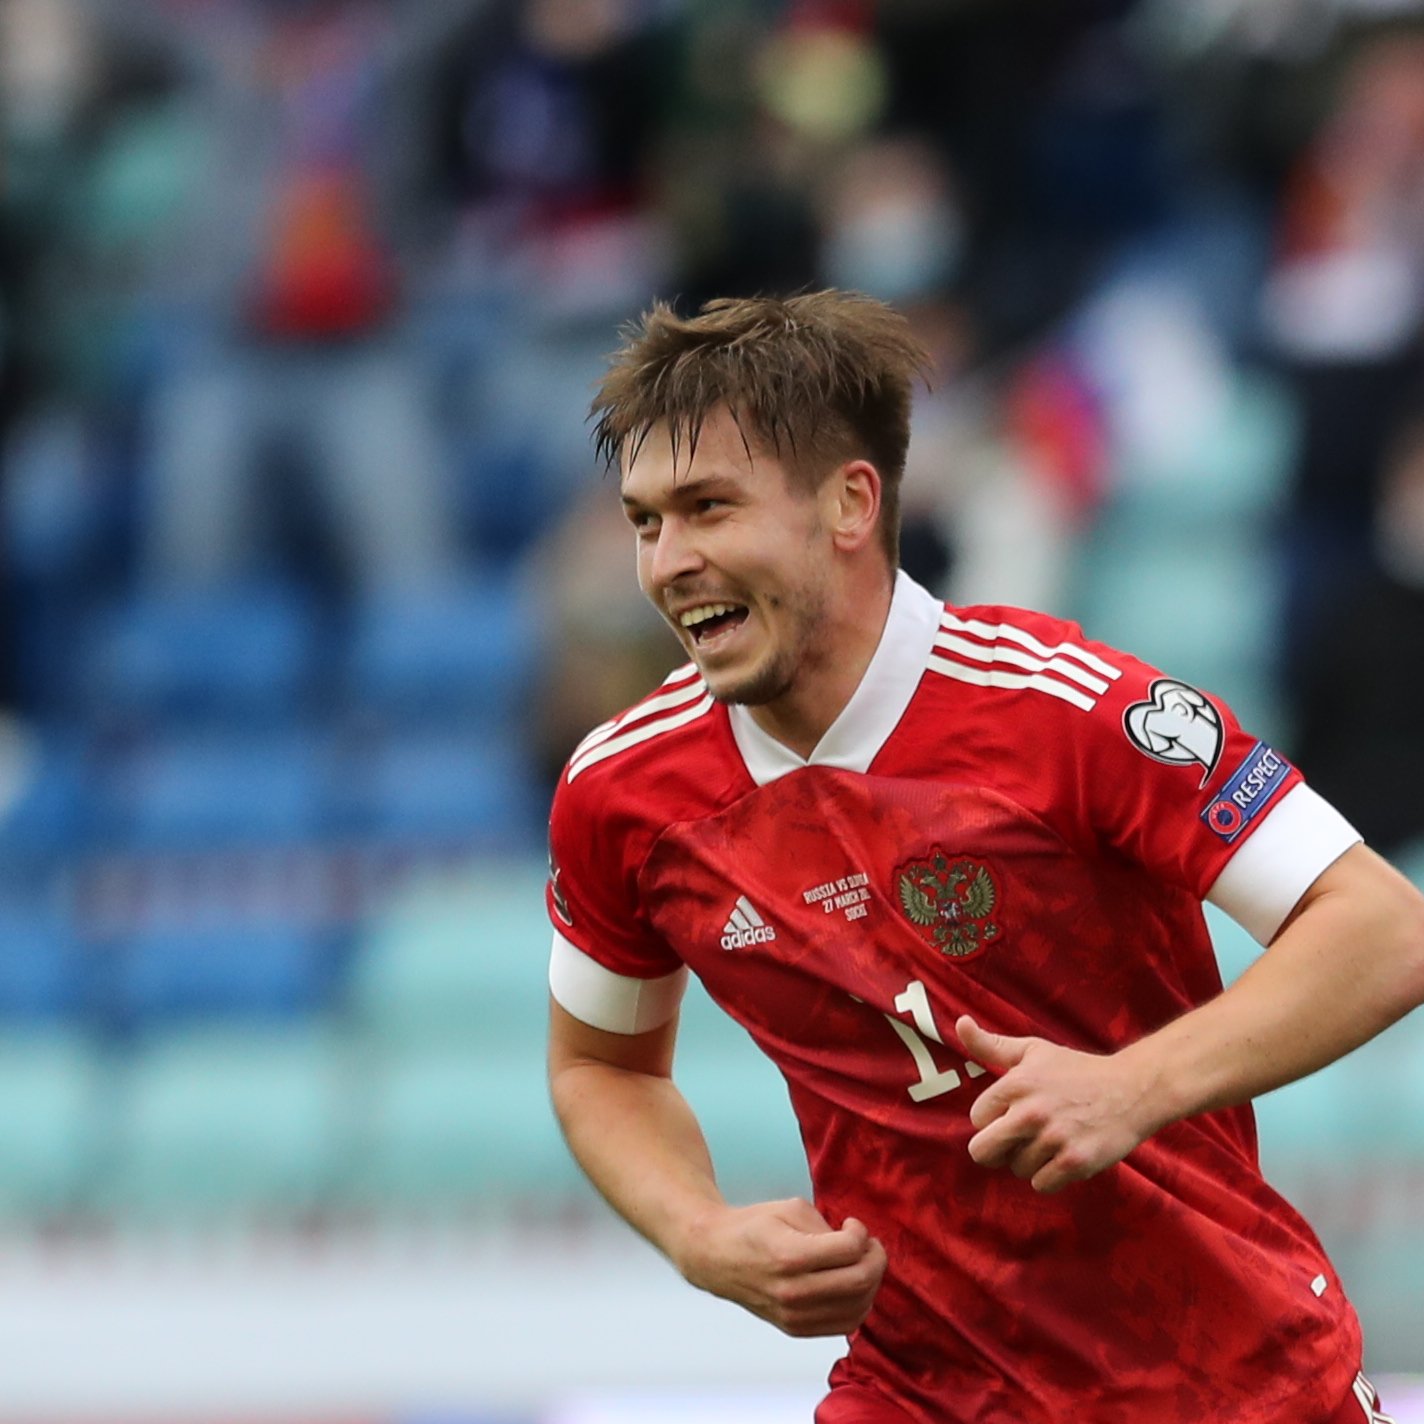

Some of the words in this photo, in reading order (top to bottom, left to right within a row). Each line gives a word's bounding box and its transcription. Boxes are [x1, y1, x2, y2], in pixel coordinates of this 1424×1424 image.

[1232, 748, 1281, 809] RESPECT
[803, 882, 837, 904] RUSSIA
[836, 878, 849, 892] VS
[822, 898, 834, 914] 27
[721, 926, 776, 950] adidas
[883, 979, 987, 1103] 1
